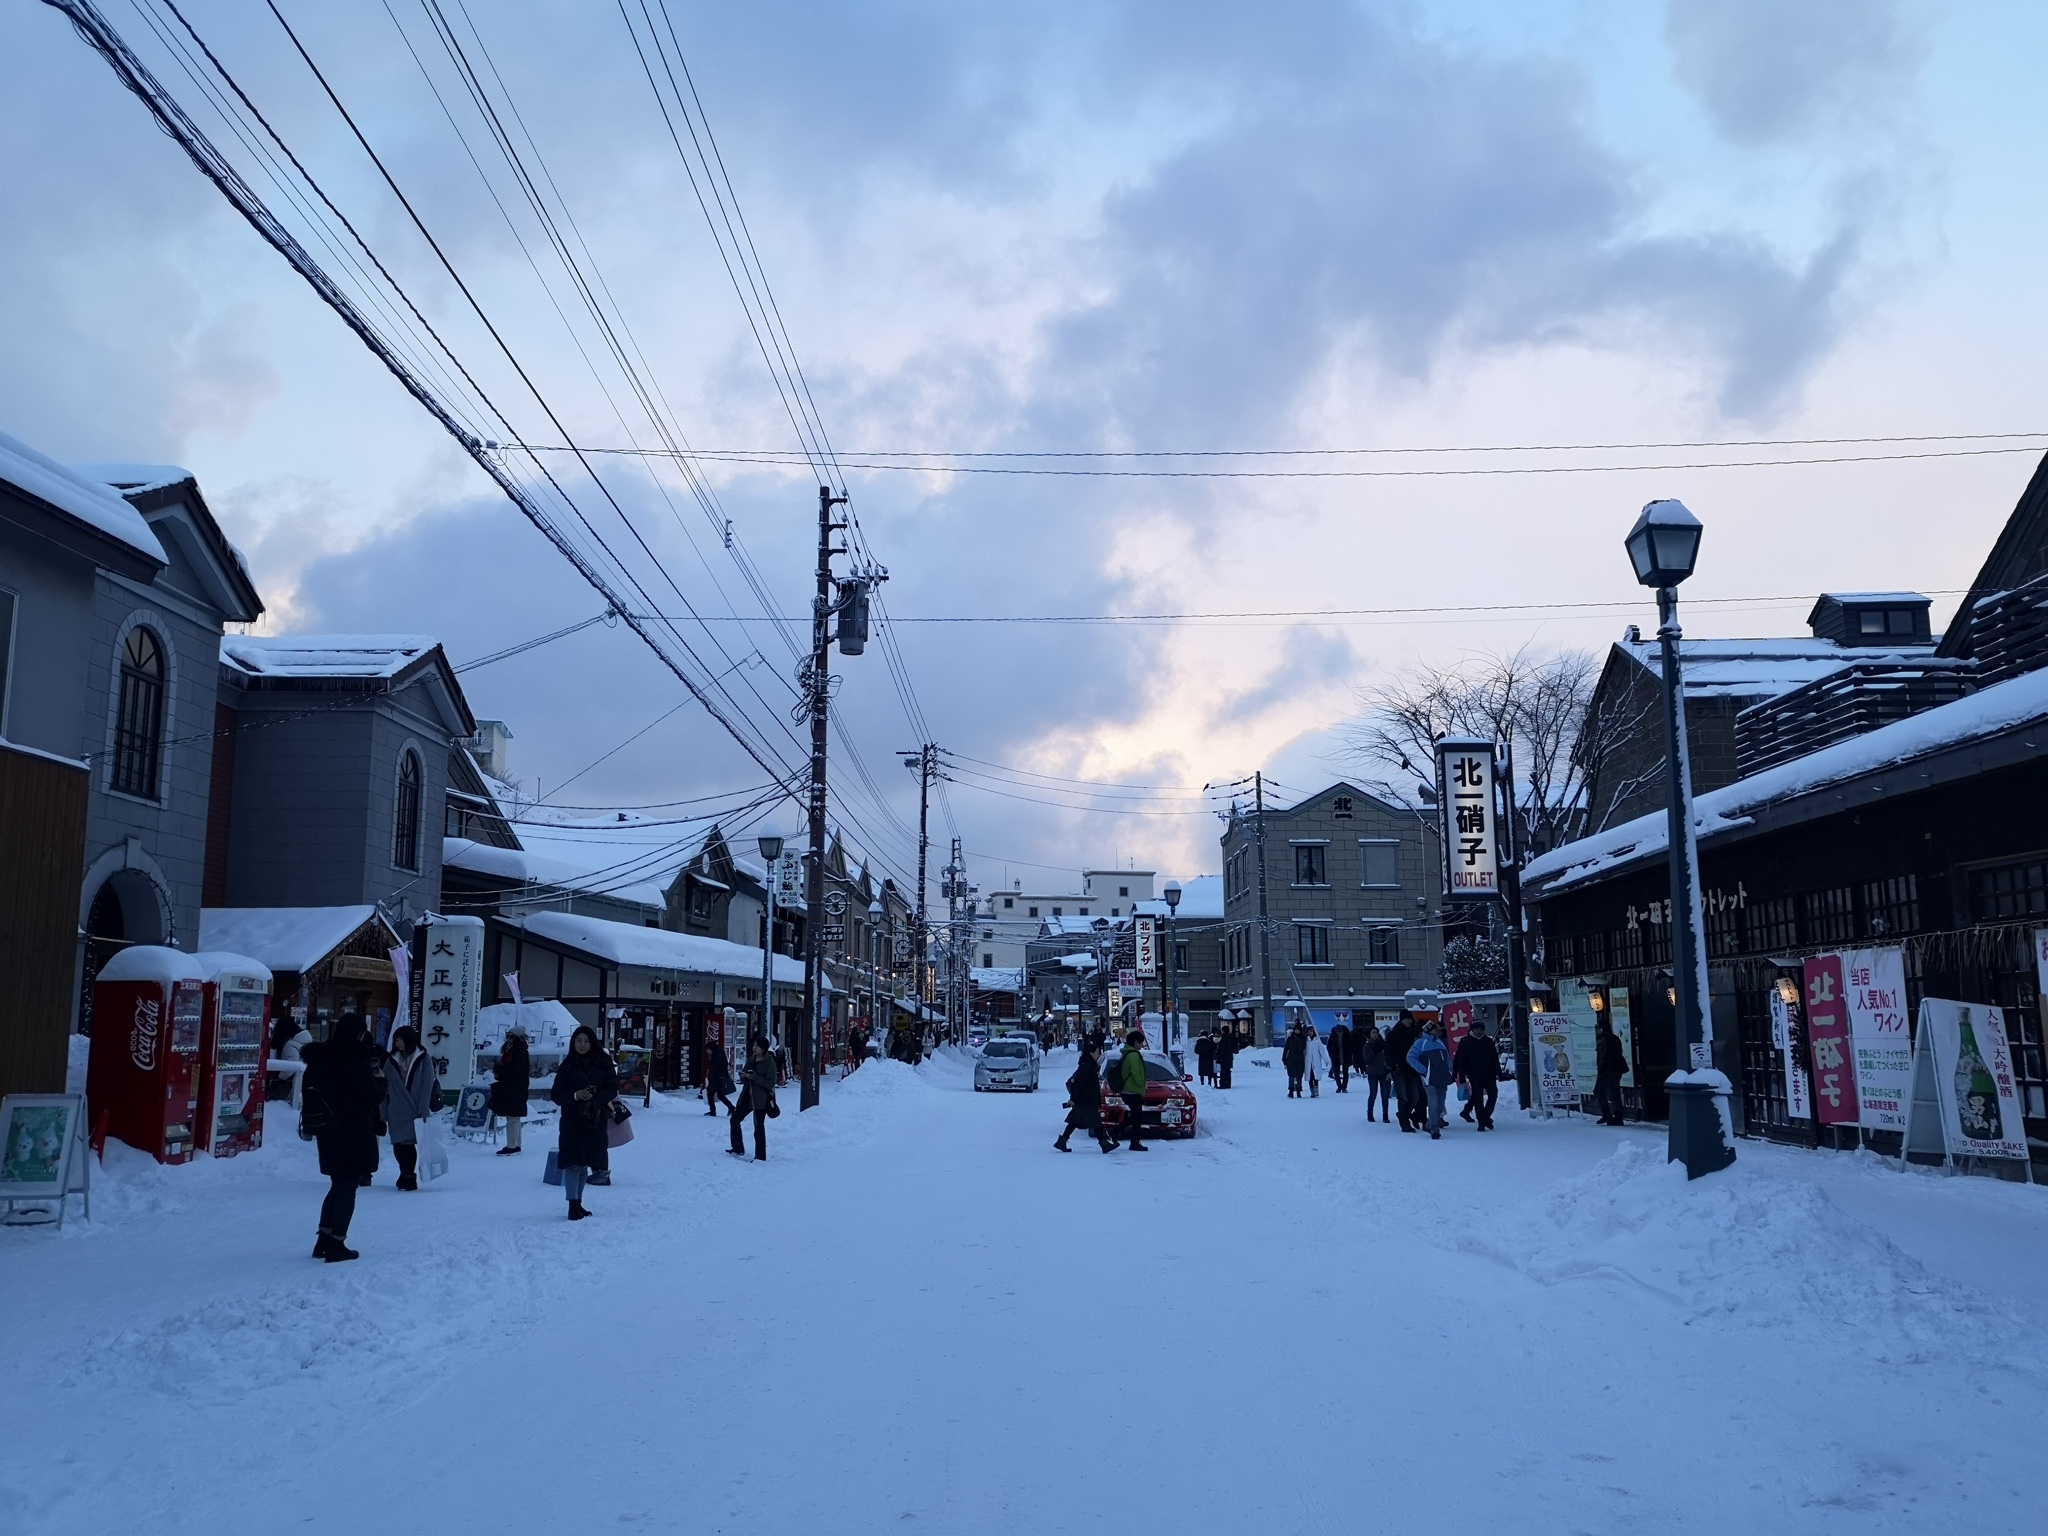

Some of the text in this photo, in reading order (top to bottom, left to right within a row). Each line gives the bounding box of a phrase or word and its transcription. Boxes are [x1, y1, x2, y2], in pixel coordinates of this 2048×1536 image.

[1334, 797, 1352, 819] 北一
[1452, 758, 1486, 866] 北一硝子
[1454, 872, 1494, 887] OUTLET
[1140, 921, 1152, 965] 北一プラザ
[413, 969, 422, 998] Taisho
[1851, 967, 1871, 986] 当店
[1857, 988, 1897, 1011] 人気No.1
[1874, 1012, 1904, 1033] ワイン
[1810, 971, 1844, 1107] 北一硝子
[1543, 1079, 1576, 1087] OUTLET
[1970, 1140, 1999, 1149] Quality
[2002, 1141, 2025, 1151] SAKE
